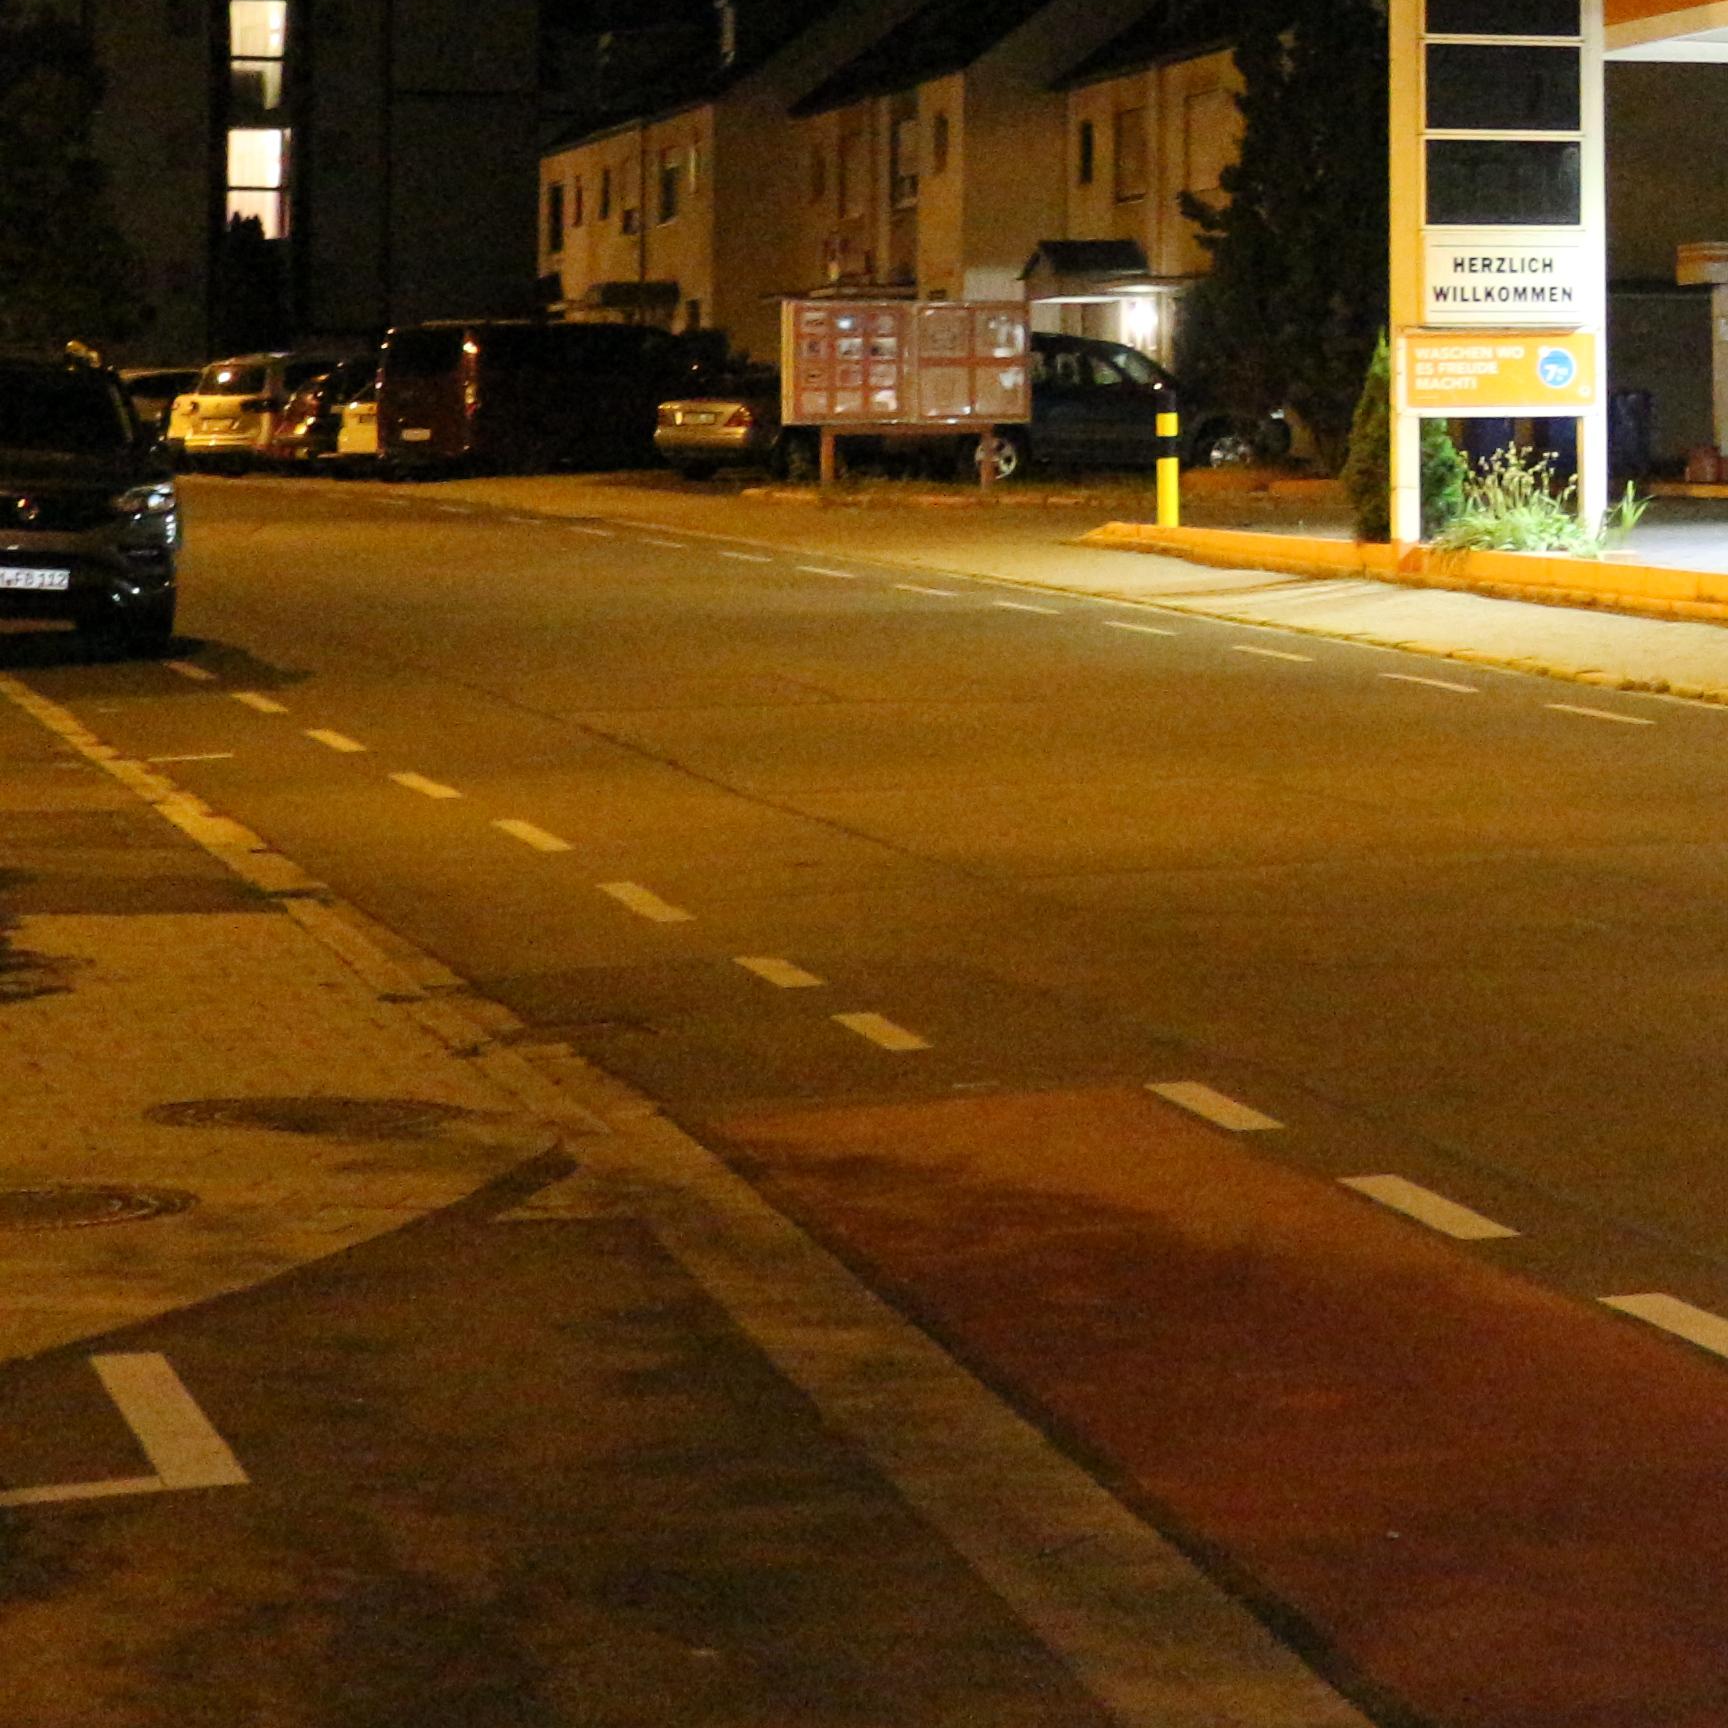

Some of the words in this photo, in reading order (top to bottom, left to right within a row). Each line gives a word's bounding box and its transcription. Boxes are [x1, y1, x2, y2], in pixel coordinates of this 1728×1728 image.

[1453, 256, 1553, 274] HERZLICH
[1433, 285, 1573, 303] WILLKOMMEN
[1414, 346, 1493, 360] WASCHEN
